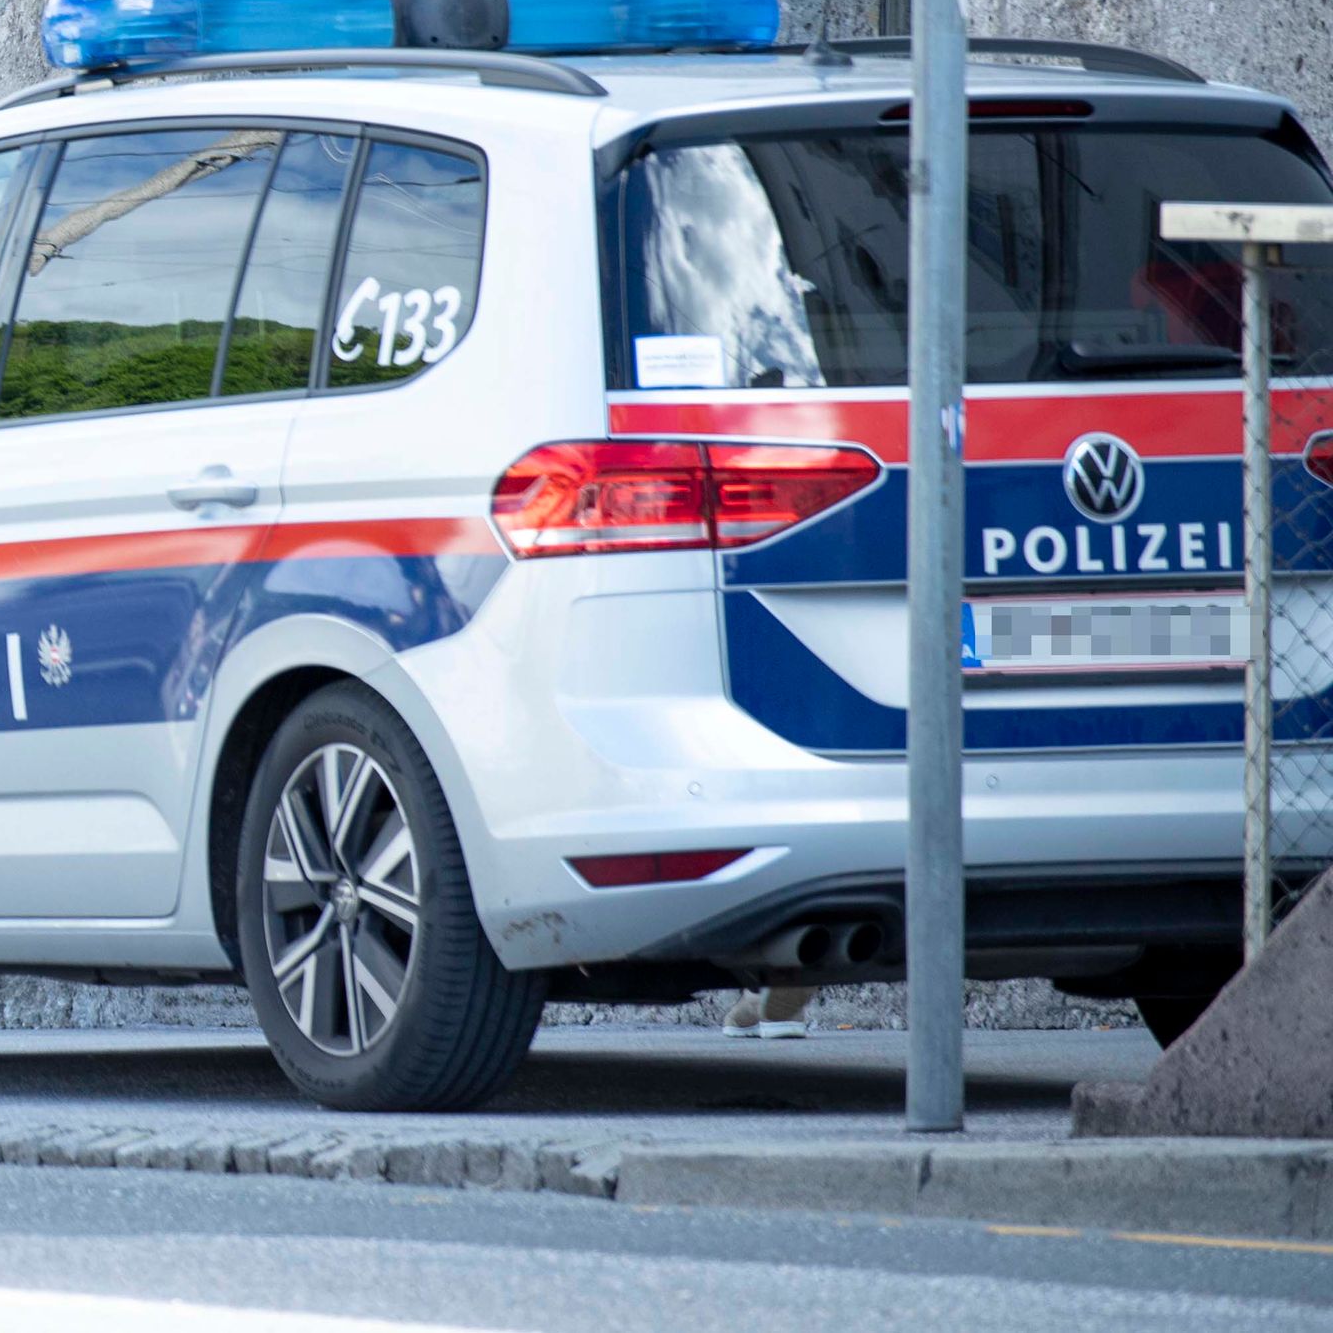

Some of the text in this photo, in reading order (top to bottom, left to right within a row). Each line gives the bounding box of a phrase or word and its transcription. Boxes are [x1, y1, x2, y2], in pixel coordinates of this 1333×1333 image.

[377, 285, 461, 366] 133
[1066, 435, 1142, 520] VW
[982, 521, 1233, 575] POLIZEI
